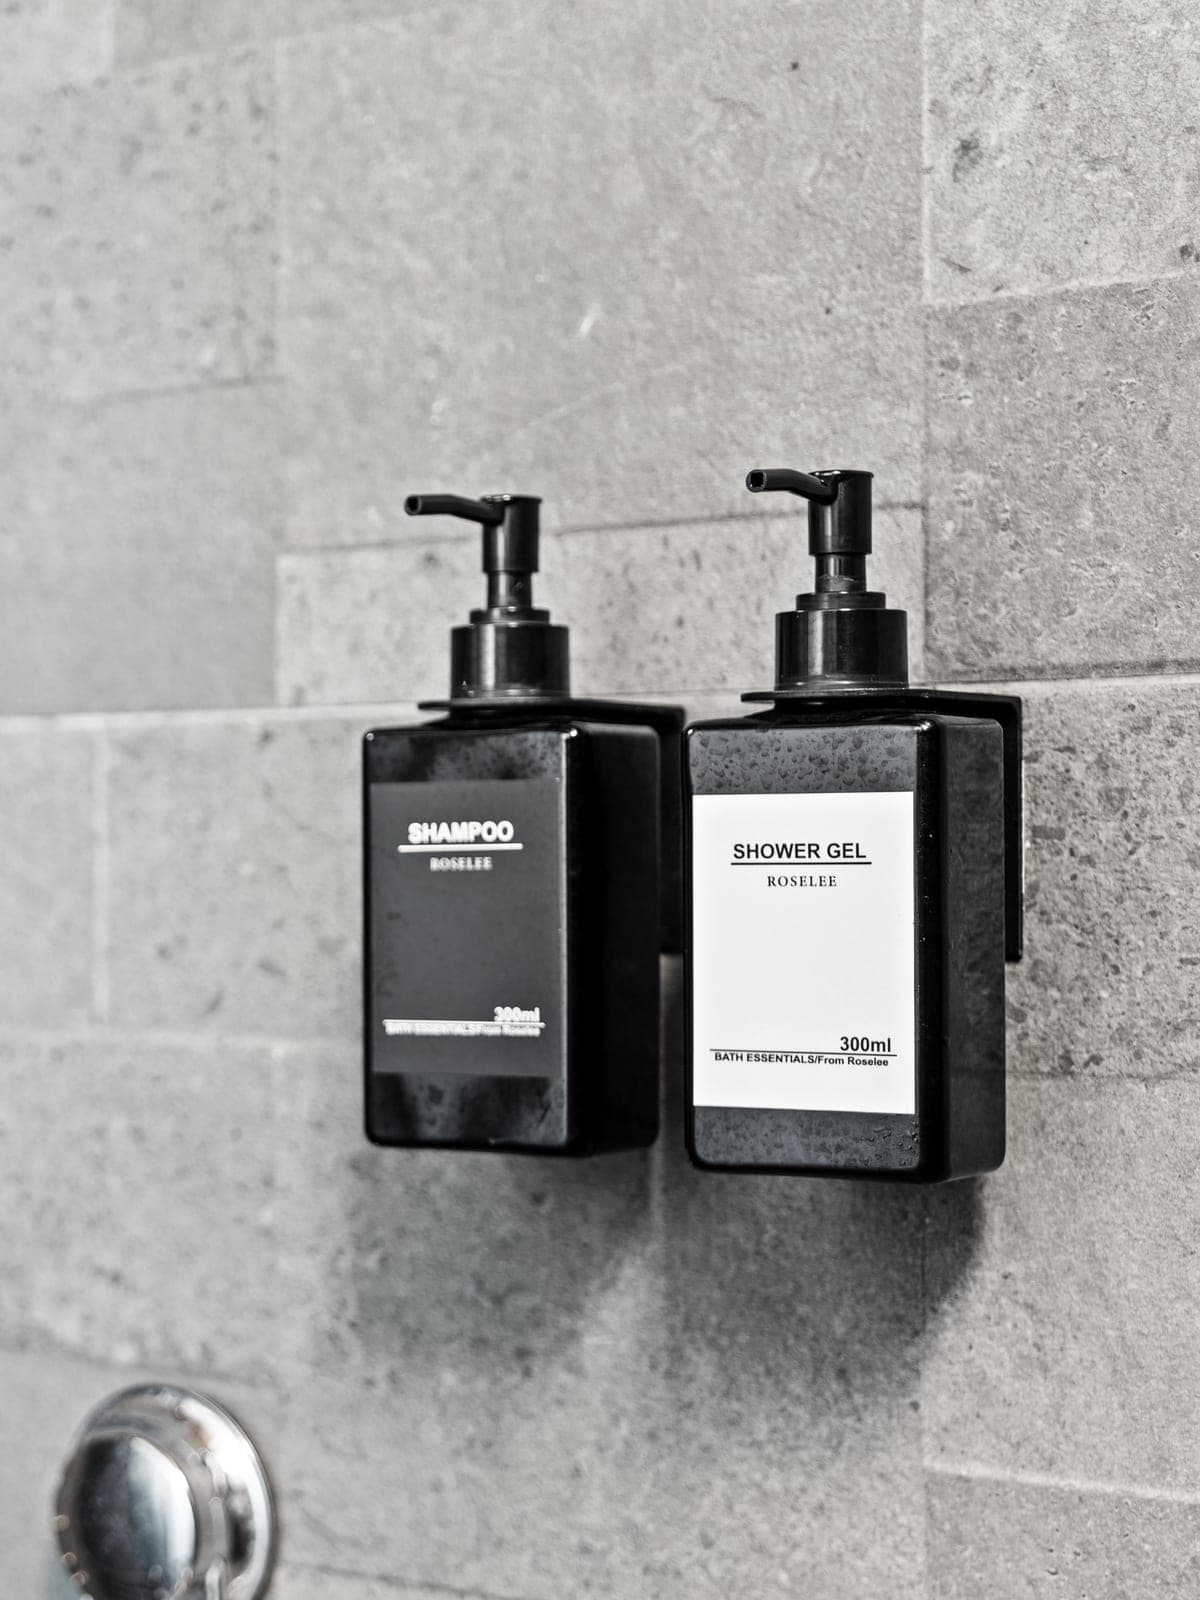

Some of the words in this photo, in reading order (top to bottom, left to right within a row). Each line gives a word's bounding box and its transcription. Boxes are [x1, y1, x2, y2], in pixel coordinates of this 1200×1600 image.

[407, 820, 515, 844] SHAMPOO
[733, 843, 821, 859] SHOWER
[827, 842, 867, 859] GEL
[429, 856, 493, 872] ROSELEE
[767, 875, 837, 887] ROSELEE
[839, 1036, 892, 1053] 300ml
[714, 1052, 744, 1062] BATH
[746, 1053, 845, 1066] ESSENTIALS/From
[847, 1056, 889, 1067] Roselee
